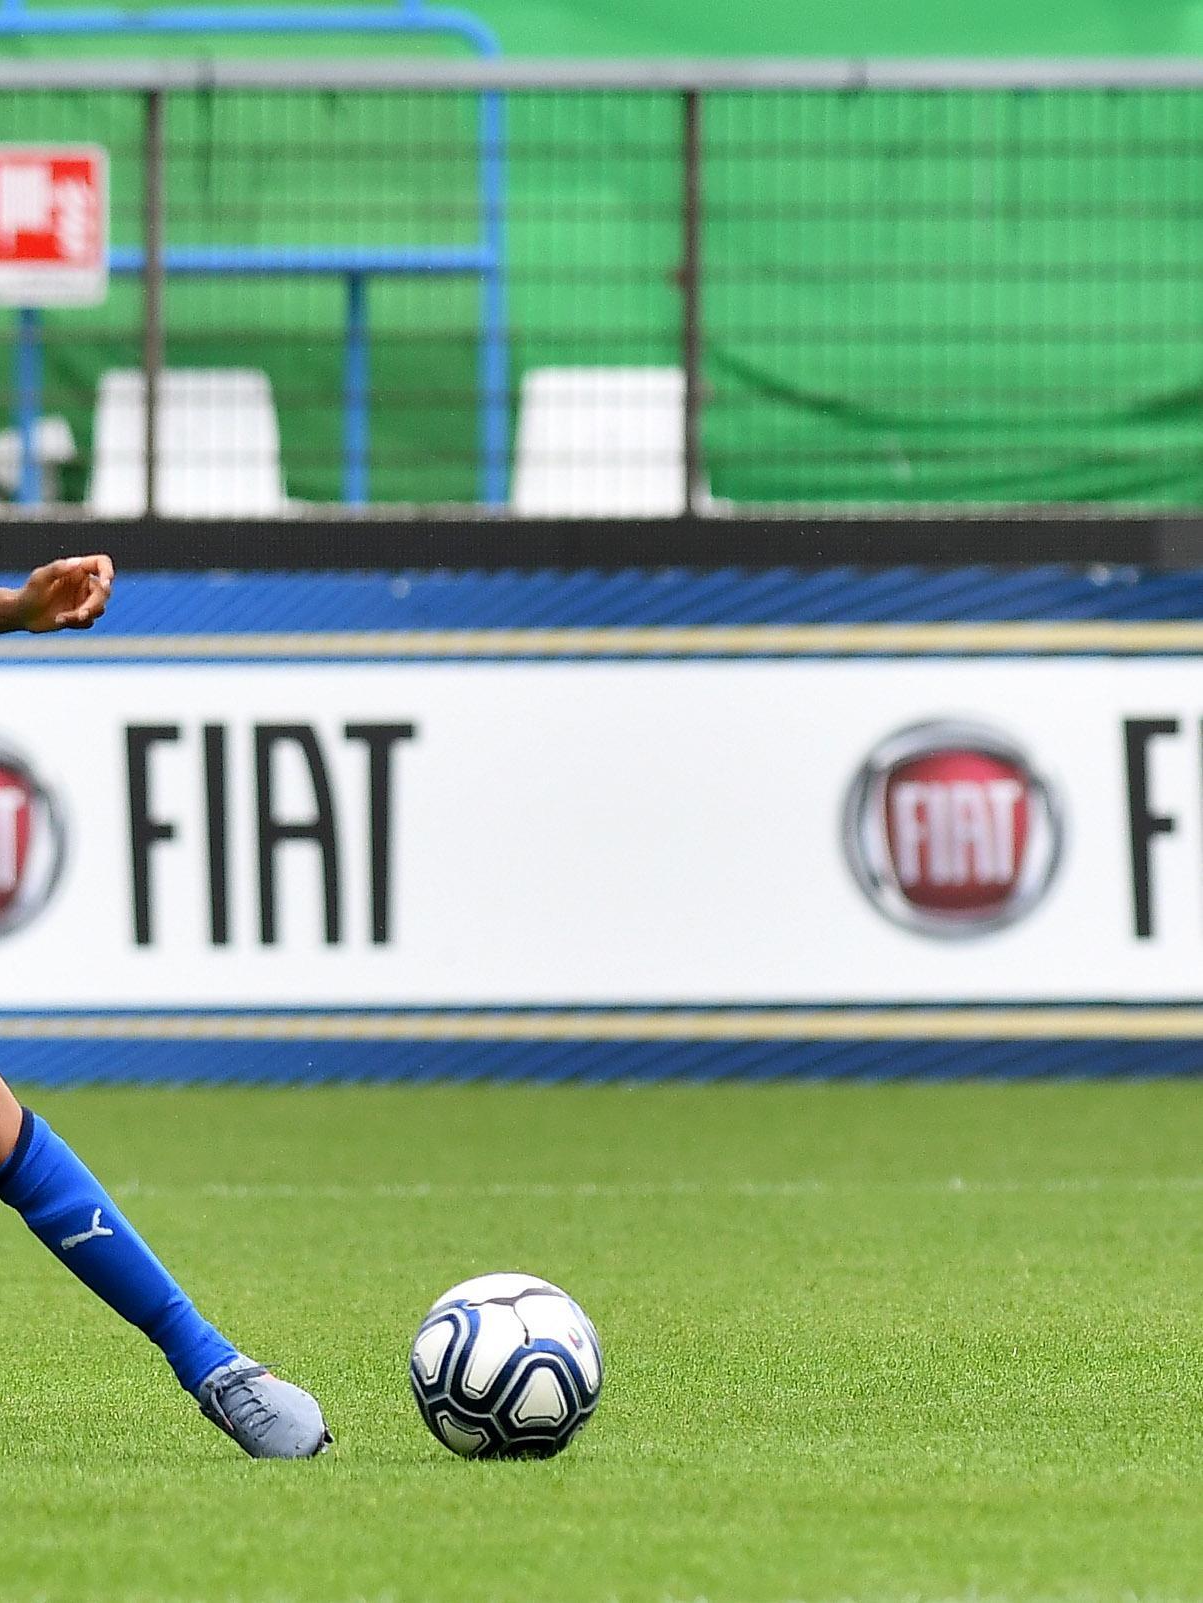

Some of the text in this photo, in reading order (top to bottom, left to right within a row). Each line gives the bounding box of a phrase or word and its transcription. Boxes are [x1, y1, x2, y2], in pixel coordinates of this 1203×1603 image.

[124, 723, 416, 946] FIAT
[892, 780, 1024, 888] FIAT
[1123, 719, 1203, 940] F
